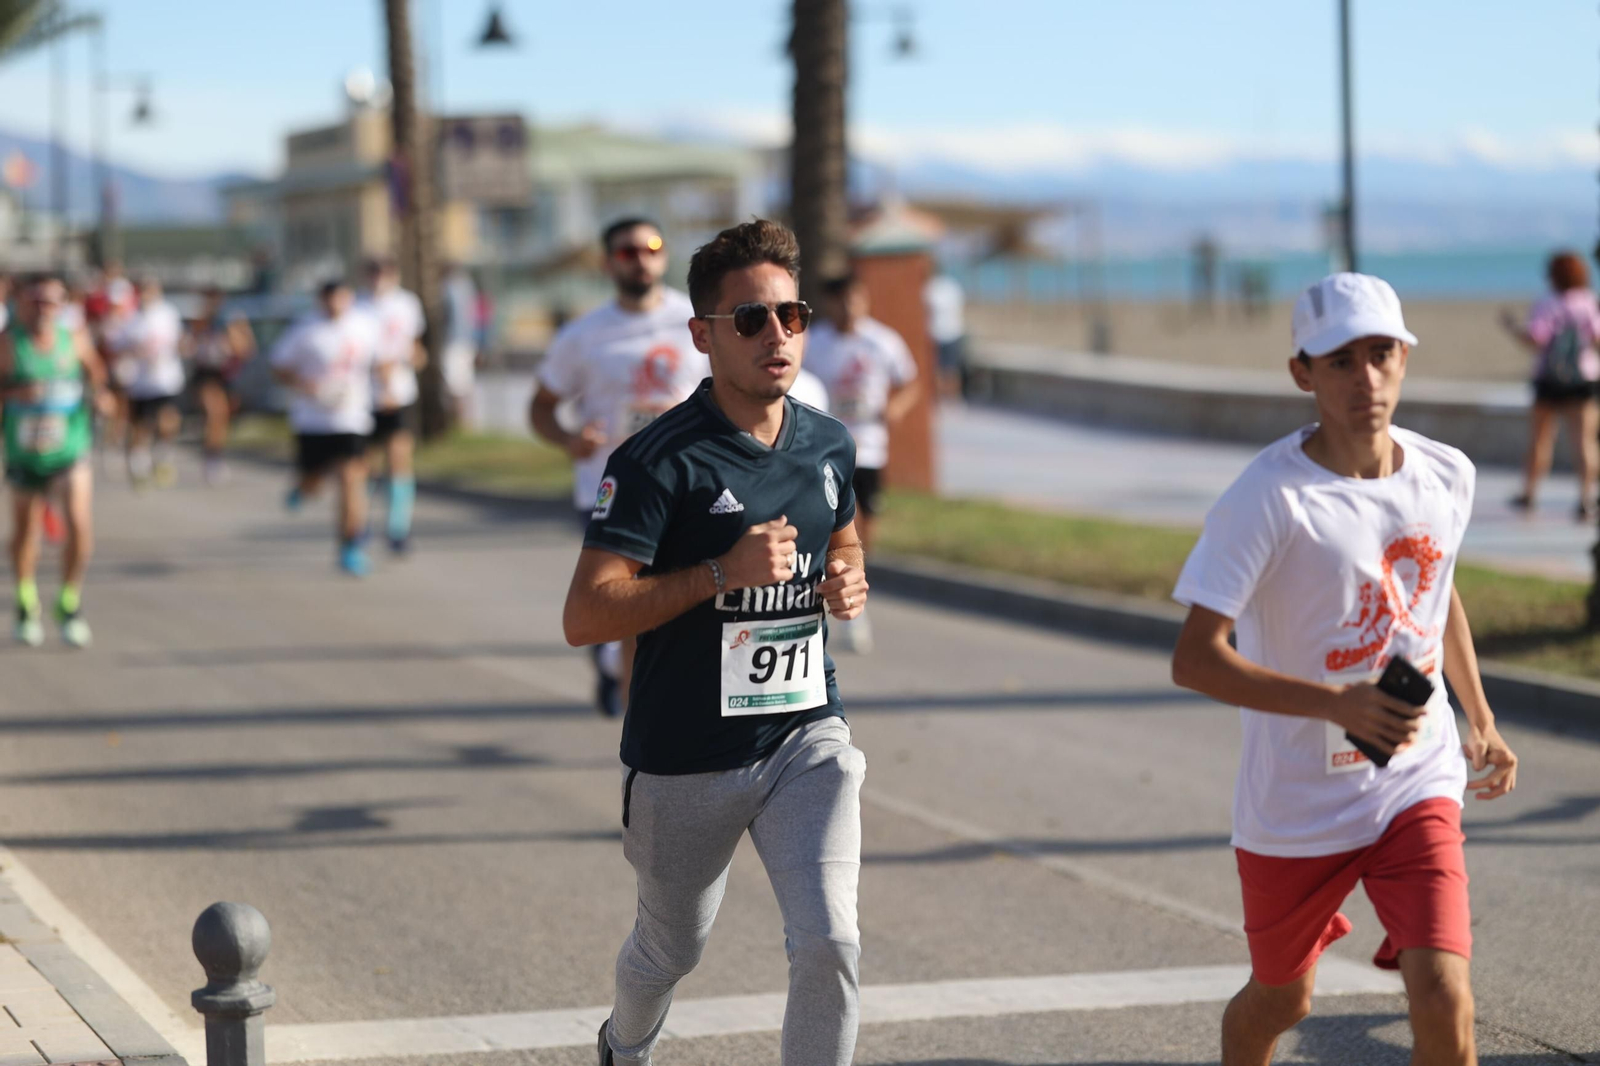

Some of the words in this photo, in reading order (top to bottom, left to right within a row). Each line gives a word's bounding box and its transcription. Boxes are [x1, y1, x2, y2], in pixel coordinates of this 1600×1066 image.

[709, 503, 745, 514] adidas
[791, 550, 812, 578] ly
[749, 640, 809, 685] 911
[730, 696, 749, 708] 024
